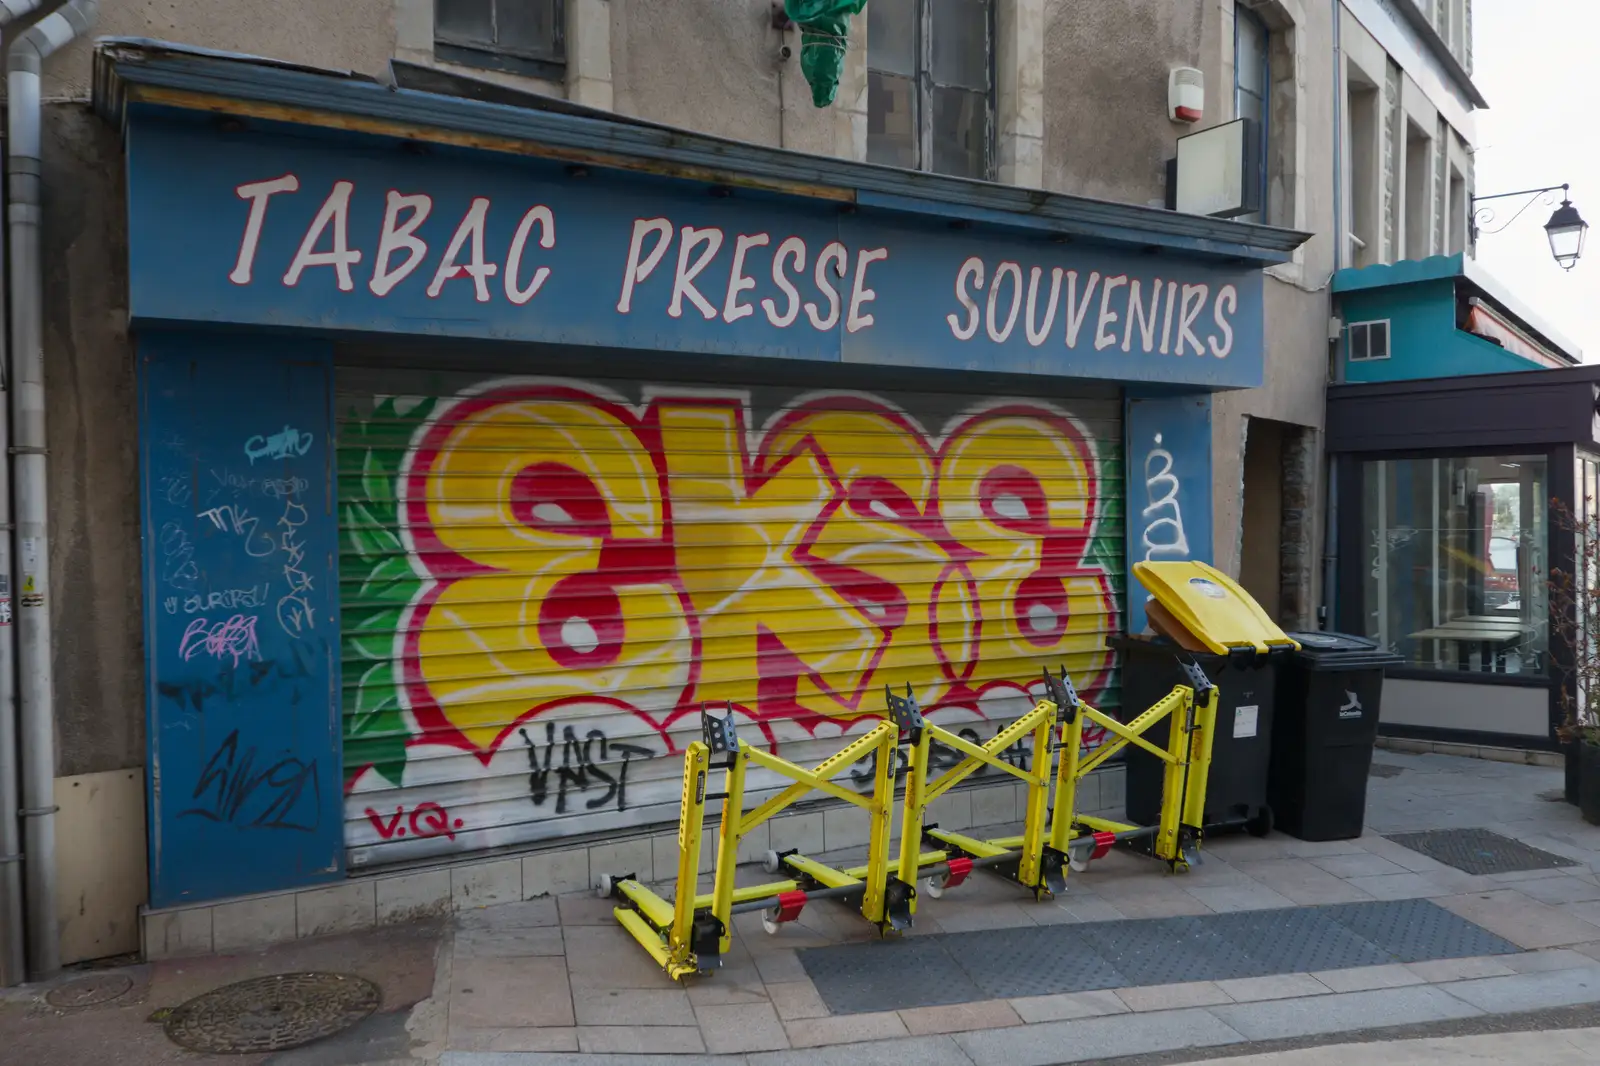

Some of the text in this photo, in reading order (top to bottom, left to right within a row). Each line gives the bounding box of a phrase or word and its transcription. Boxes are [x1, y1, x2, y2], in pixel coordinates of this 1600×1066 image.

[229, 174, 1238, 358] TABAC PRESSE SOUVENIRS
